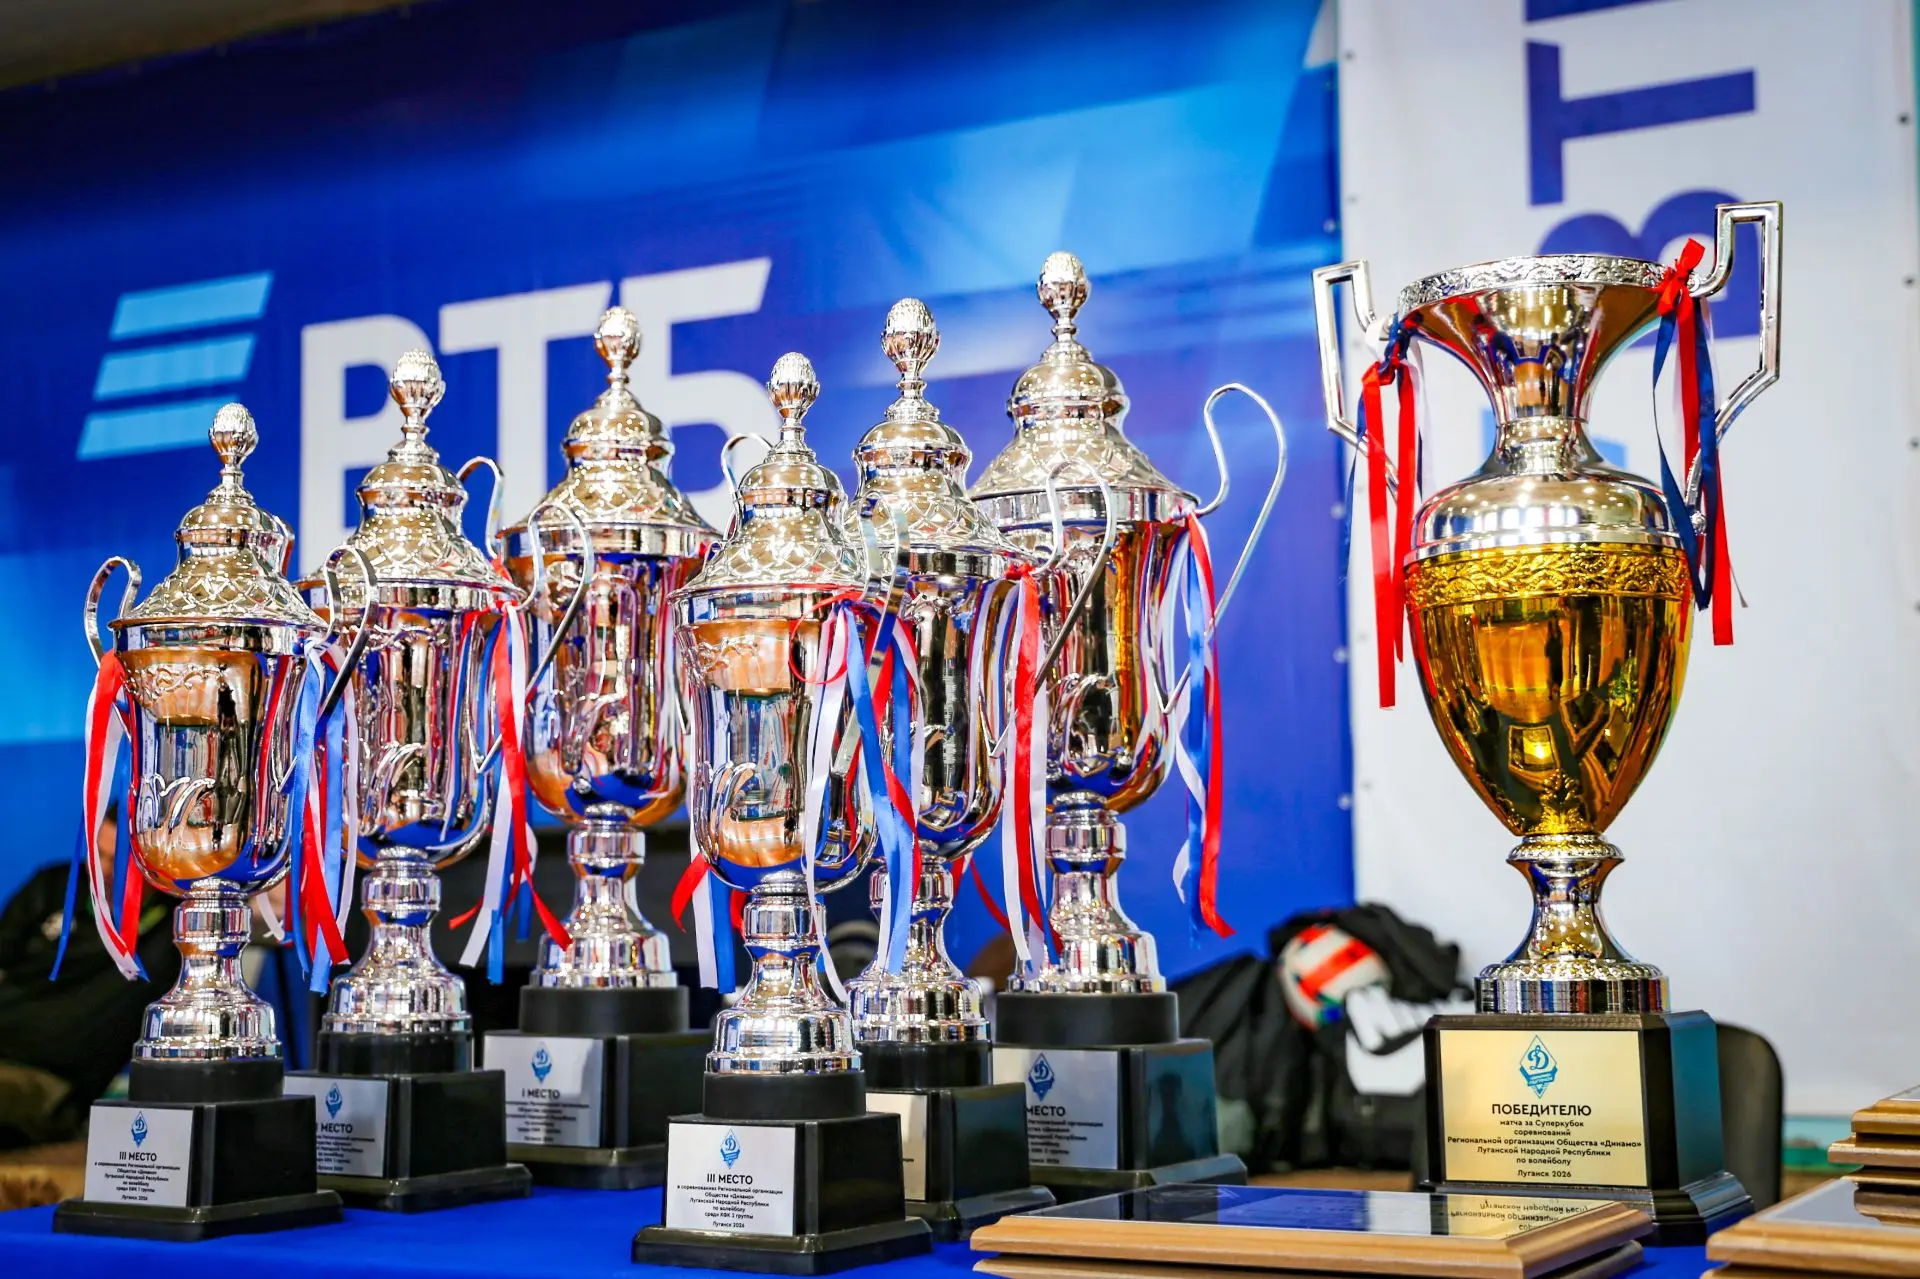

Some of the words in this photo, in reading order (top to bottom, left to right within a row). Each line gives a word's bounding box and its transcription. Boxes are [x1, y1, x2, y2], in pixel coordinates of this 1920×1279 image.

[527, 1088, 560, 1099] МЕСТО
[1492, 1104, 1591, 1117] ПОБЕДИТЕЛЮ
[320, 1123, 353, 1133] МЕСТО
[1536, 1120, 1584, 1128] Суперкубок
[1448, 1137, 1501, 1145] Региональной
[1477, 1147, 1518, 1155] Луганской
[129, 1152, 157, 1161] МЕСТО
[1529, 1158, 1571, 1166] волейболу
[707, 1173, 715, 1183] III
[719, 1174, 753, 1185] МЕСТО
[1518, 1170, 1549, 1179] Луганск
